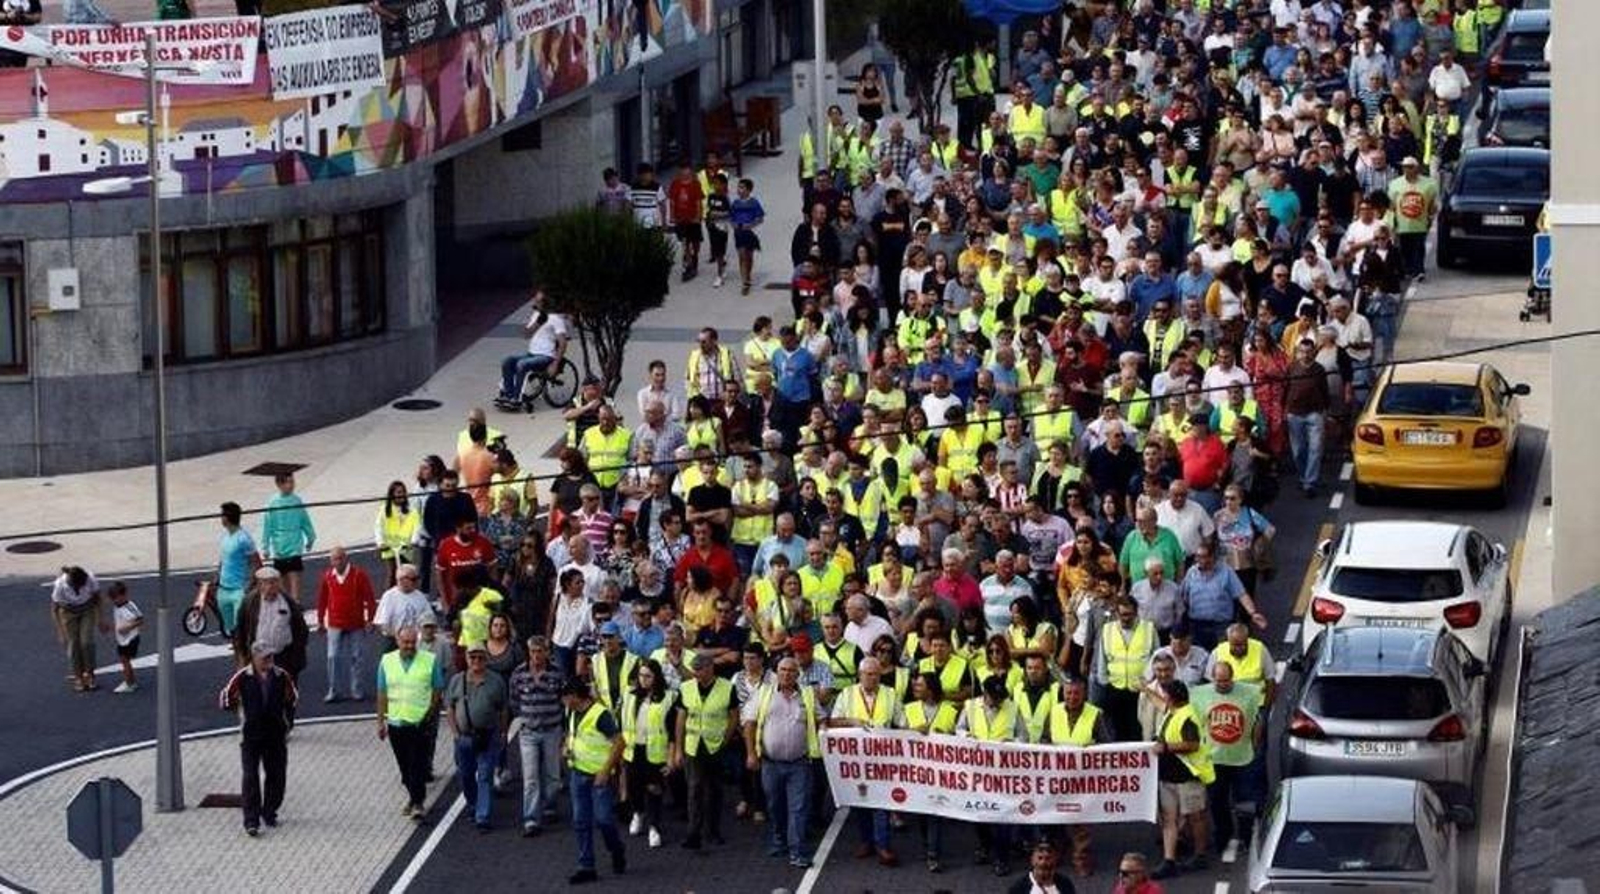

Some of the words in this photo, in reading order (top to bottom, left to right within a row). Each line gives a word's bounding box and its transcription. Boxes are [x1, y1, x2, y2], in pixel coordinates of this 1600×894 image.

[52, 29, 91, 46] POR
[155, 20, 259, 42] TRANSICIÓN
[189, 42, 245, 61] XUSTA
[827, 737, 858, 755] POR
[863, 738, 904, 757] UNHA
[908, 740, 994, 768] TRANSICIÓN
[998, 750, 1051, 770] XUSTA
[1055, 751, 1077, 770] NA
[1081, 751, 1151, 770] DEFENSA
[839, 761, 861, 779] DO
[865, 762, 936, 786] EMPREGO
[939, 769, 968, 791] NAS
[972, 772, 1032, 795] PONTES
[1035, 776, 1045, 794] E
[1049, 775, 1141, 795] COMARCAS
